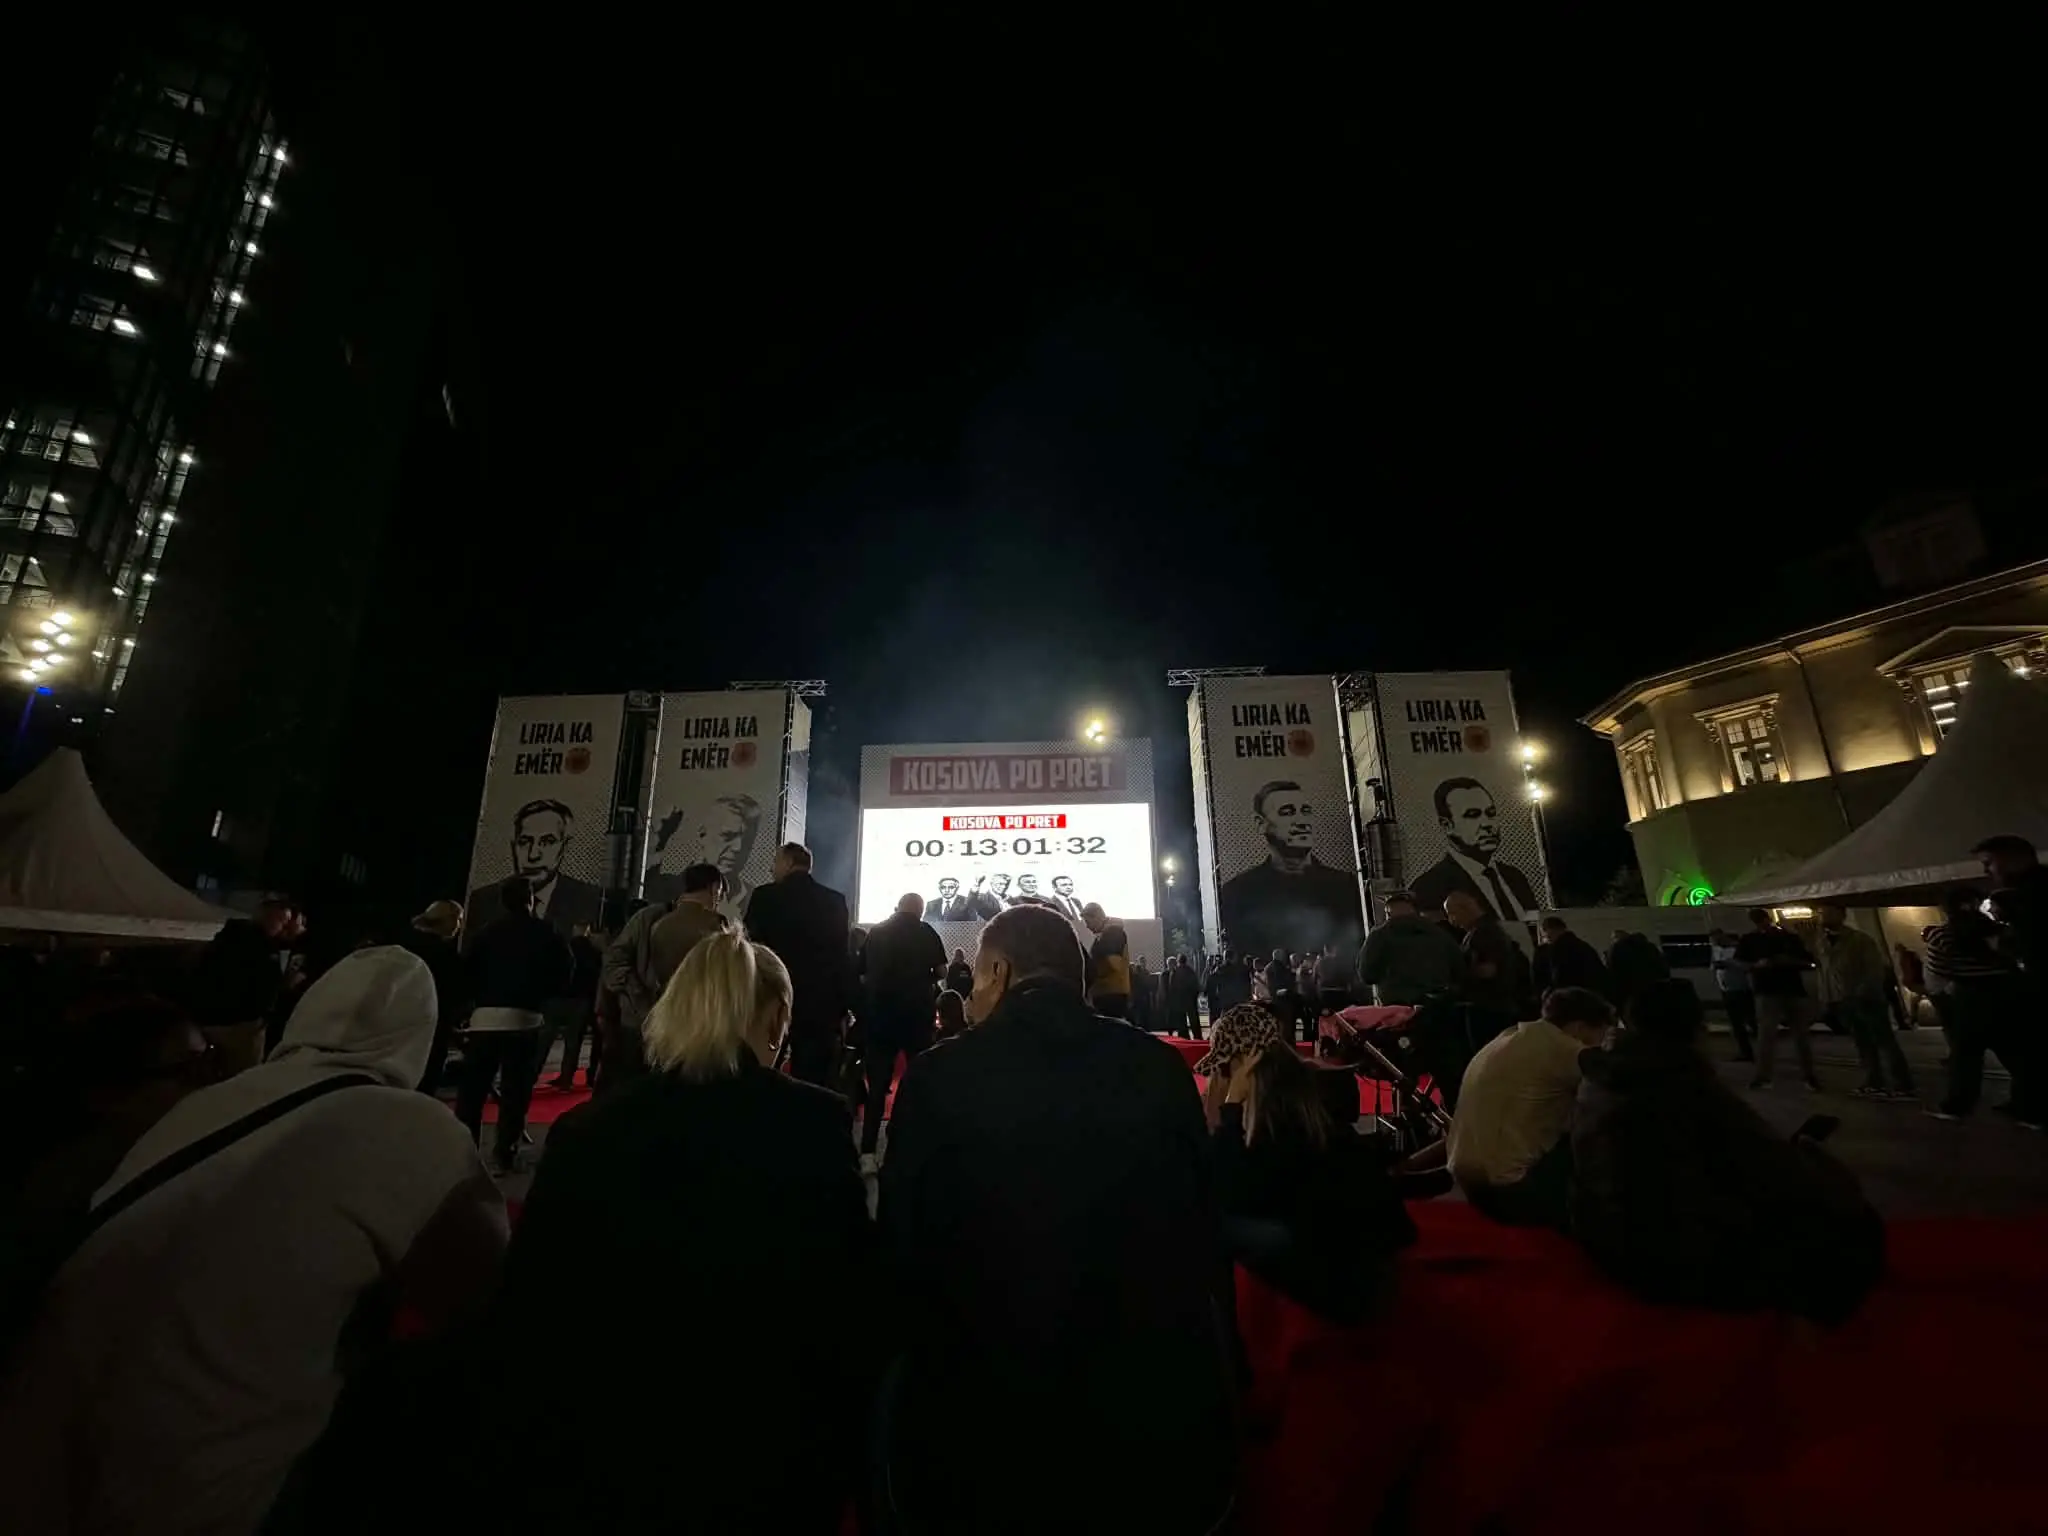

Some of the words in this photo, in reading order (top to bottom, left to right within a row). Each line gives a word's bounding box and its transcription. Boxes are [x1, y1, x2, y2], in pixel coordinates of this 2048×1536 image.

[1232, 703, 1282, 727] LIRIA
[1285, 703, 1311, 725] KA
[1406, 699, 1456, 722] LIRIA
[1459, 699, 1486, 721] KA
[519, 723, 565, 745] LIRIA
[569, 722, 593, 742] KA
[684, 717, 730, 740] LIRIA
[733, 716, 758, 737] KA
[1410, 726, 1463, 753] EMËR
[680, 743, 729, 770] EMËR
[1235, 730, 1287, 759] EMËR
[514, 747, 562, 775] EMËR
[902, 758, 1000, 791] KOSOVA
[1009, 758, 1042, 790] PO
[1050, 755, 1113, 788] PRET
[949, 816, 1002, 829] KOSOVA
[1005, 816, 1024, 828] PO
[1026, 815, 1060, 828] PRET
[905, 836, 1107, 858] 00:13:01:32
